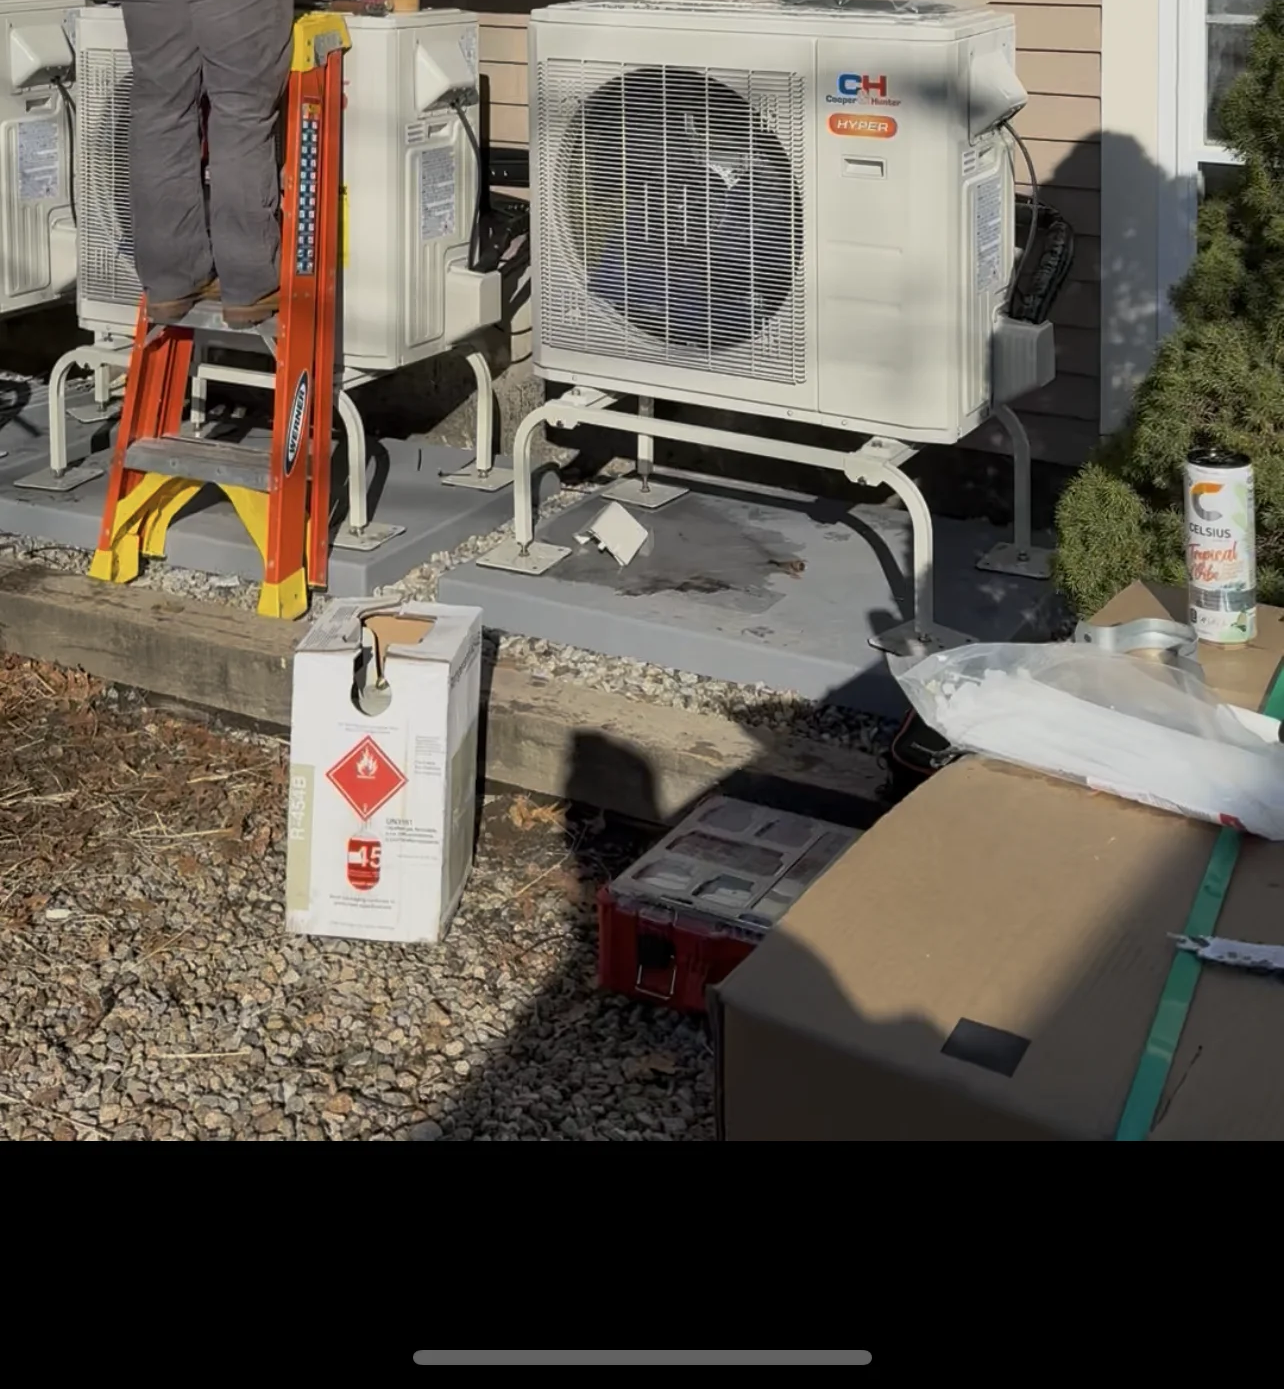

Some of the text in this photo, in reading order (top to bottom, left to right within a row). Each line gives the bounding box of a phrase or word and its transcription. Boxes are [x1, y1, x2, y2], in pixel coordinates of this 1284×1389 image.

[838, 74, 888, 98] CH
[826, 95, 902, 107] Cooper Hunter
[837, 119, 889, 132] HYPER
[290, 389, 305, 453] WERNER
[1189, 522, 1232, 539] CELSIUS
[290, 775, 307, 841] R-454B
